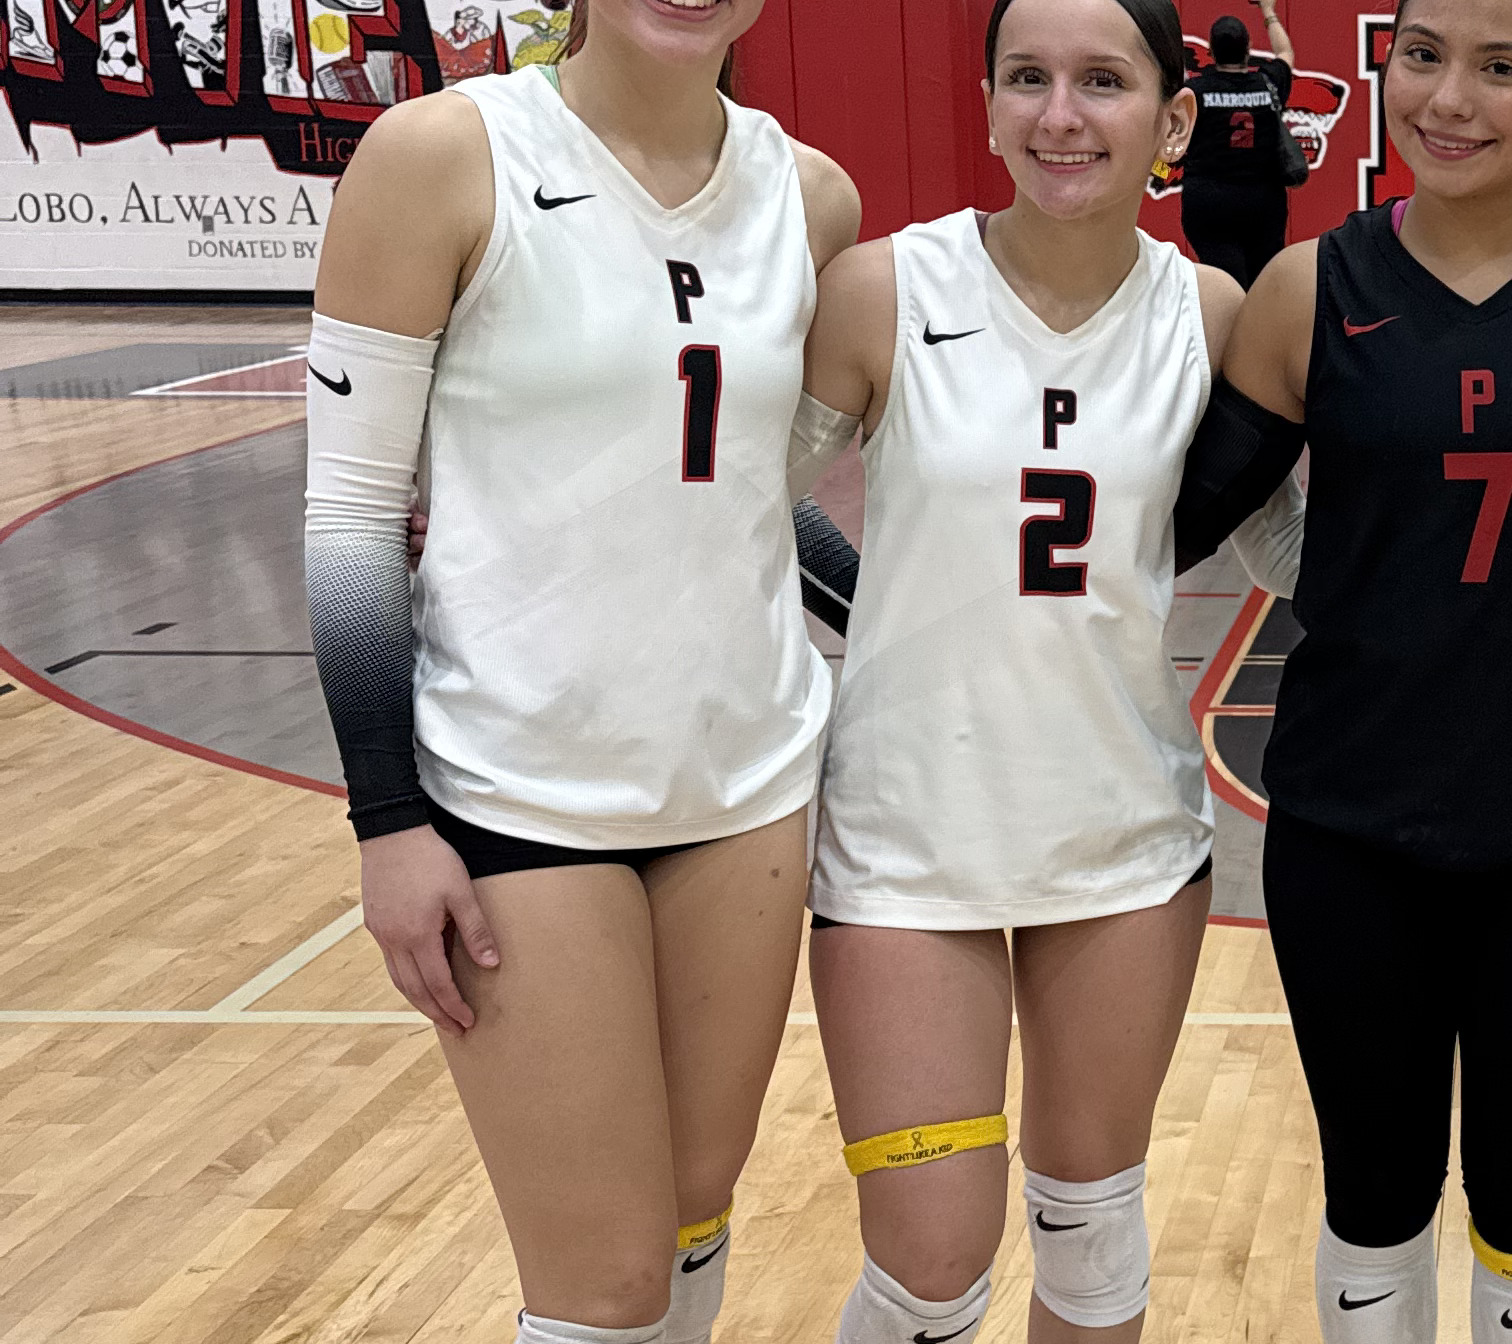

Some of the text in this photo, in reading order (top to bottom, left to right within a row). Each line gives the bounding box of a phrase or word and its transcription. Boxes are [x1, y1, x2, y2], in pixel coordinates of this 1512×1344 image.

[299, 122, 361, 163] HIG
[1229, 111, 1255, 148] 2
[120, 181, 277, 225] ALWAYS
[286, 185, 321, 227] A
[188, 240, 318, 259] DONATED BY
[665, 258, 705, 324] P
[678, 343, 722, 482] 1
[1043, 387, 1077, 450] P
[1461, 369, 1496, 433] P
[1019, 467, 1097, 596] 2
[887, 1143, 953, 1163] FIGHT LIKE A KID
